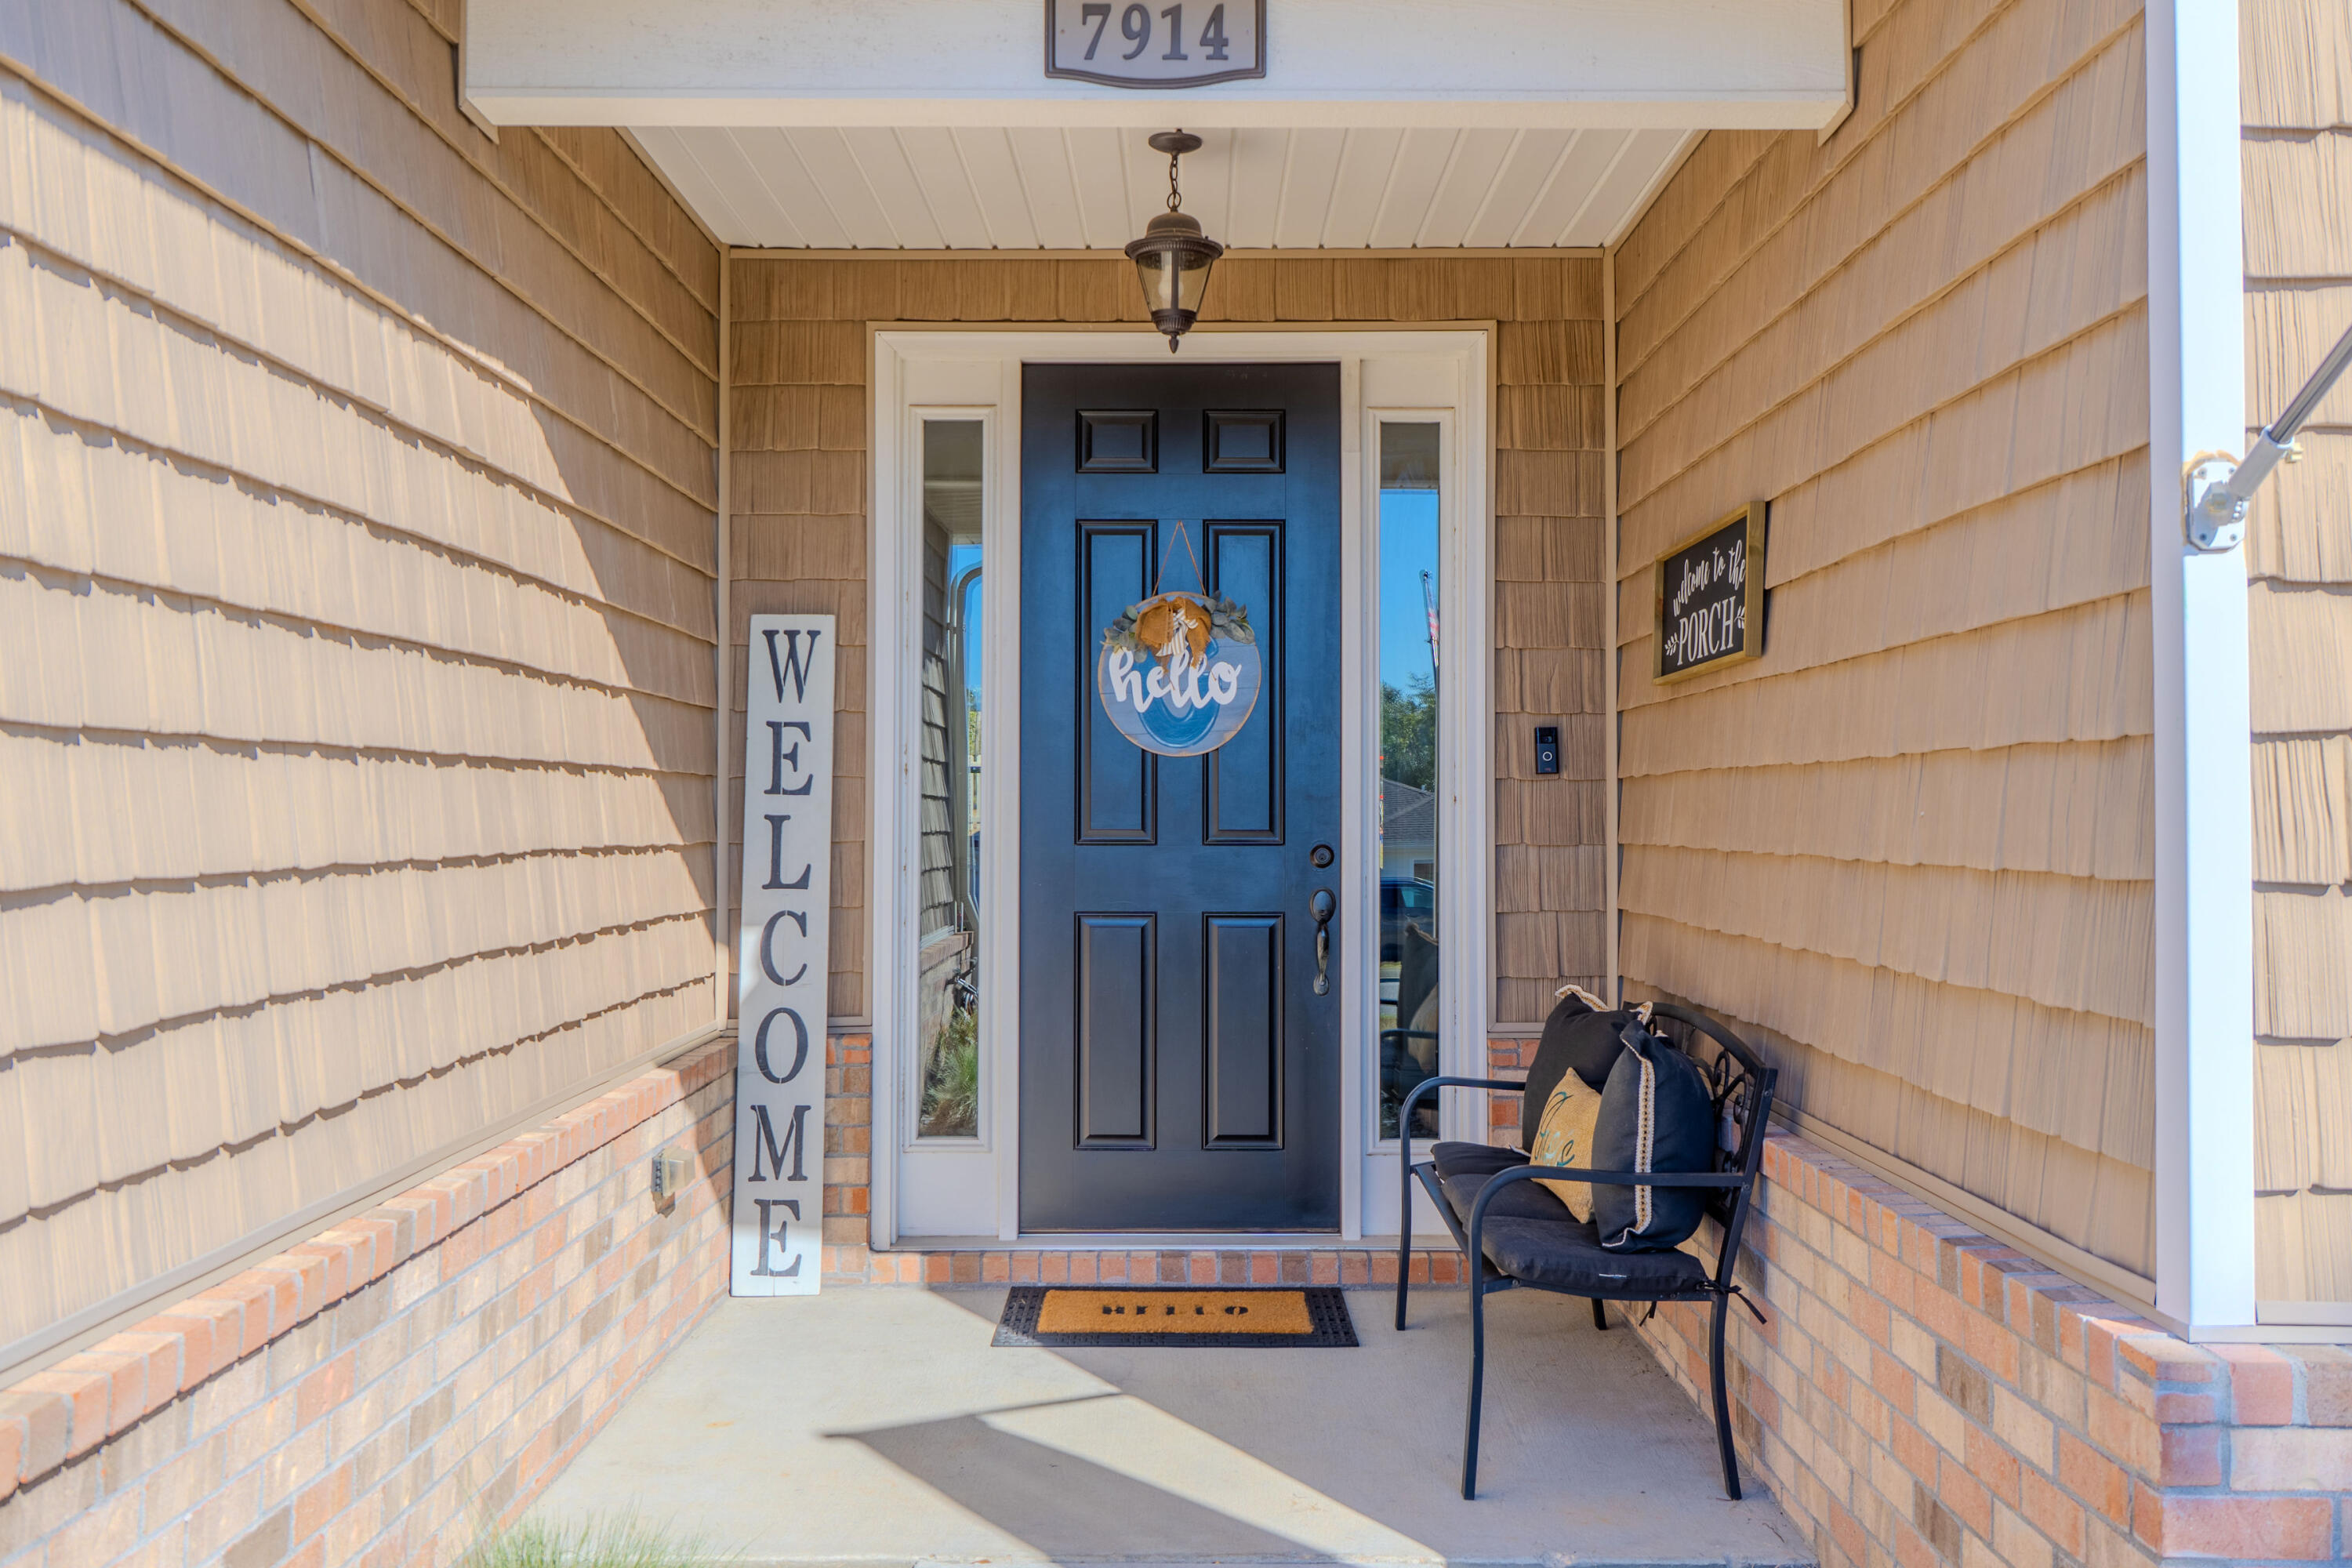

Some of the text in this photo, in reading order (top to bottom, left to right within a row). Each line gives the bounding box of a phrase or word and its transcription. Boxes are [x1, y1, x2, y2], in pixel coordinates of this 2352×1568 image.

[1081, 3, 1229, 60] 7914
[1712, 546, 1726, 583] to
[1729, 539, 1746, 591] the
[1676, 595, 1737, 666] PORCH
[1109, 646, 1242, 713] hello
[747, 630, 820, 1278] WELCOME
